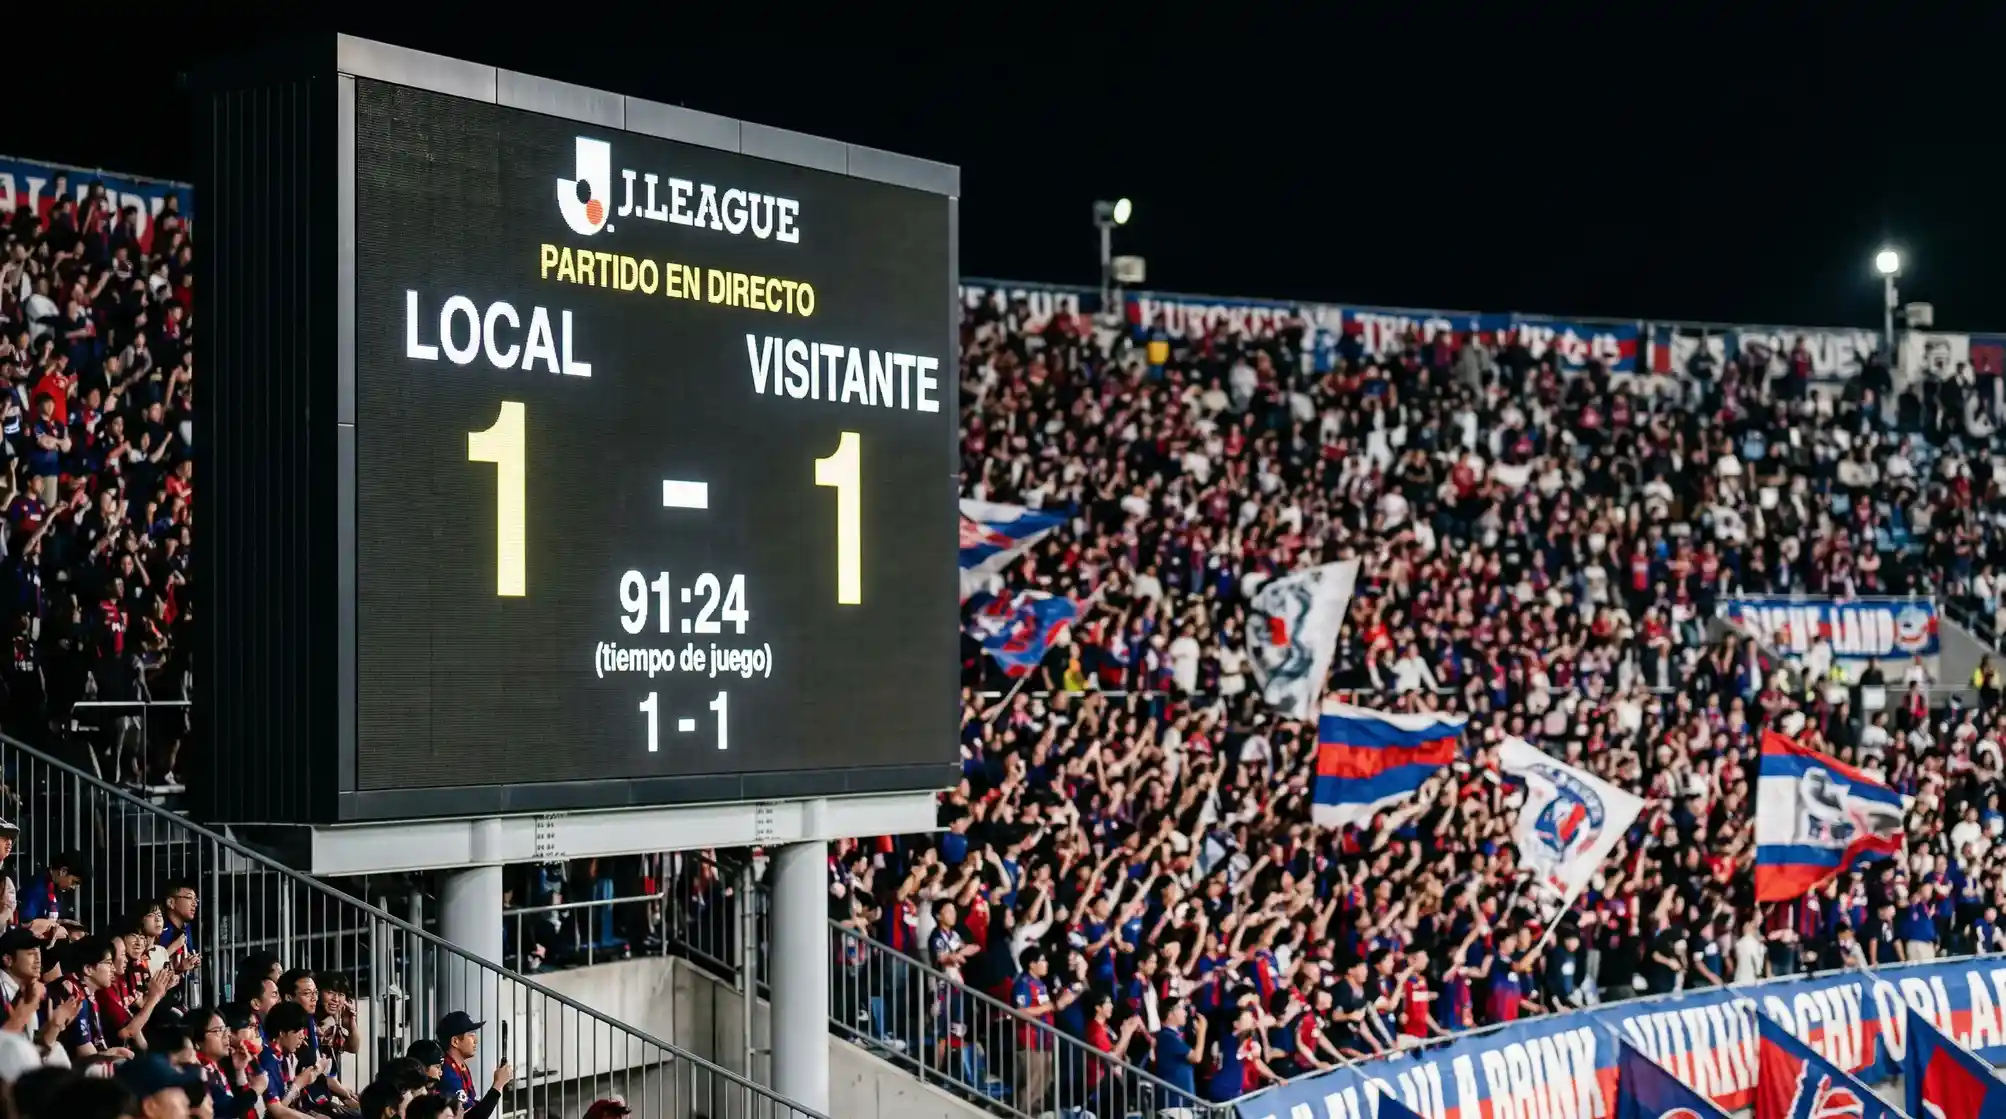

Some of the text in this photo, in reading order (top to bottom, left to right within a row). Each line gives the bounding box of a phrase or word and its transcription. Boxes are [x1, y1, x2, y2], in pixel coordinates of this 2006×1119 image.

[617, 168, 800, 244] J.LEAGUE
[541, 243, 816, 317] PARTIDO EN DIRECTO
[405, 289, 593, 378] LOCAL
[745, 333, 940, 413] VISITANTE
[467, 400, 527, 598] 1
[814, 431, 863, 605] 1
[619, 569, 750, 635] 91:24
[595, 641, 773, 679] (tiempo de juego)
[639, 691, 659, 753] 1
[709, 690, 728, 750] 1
